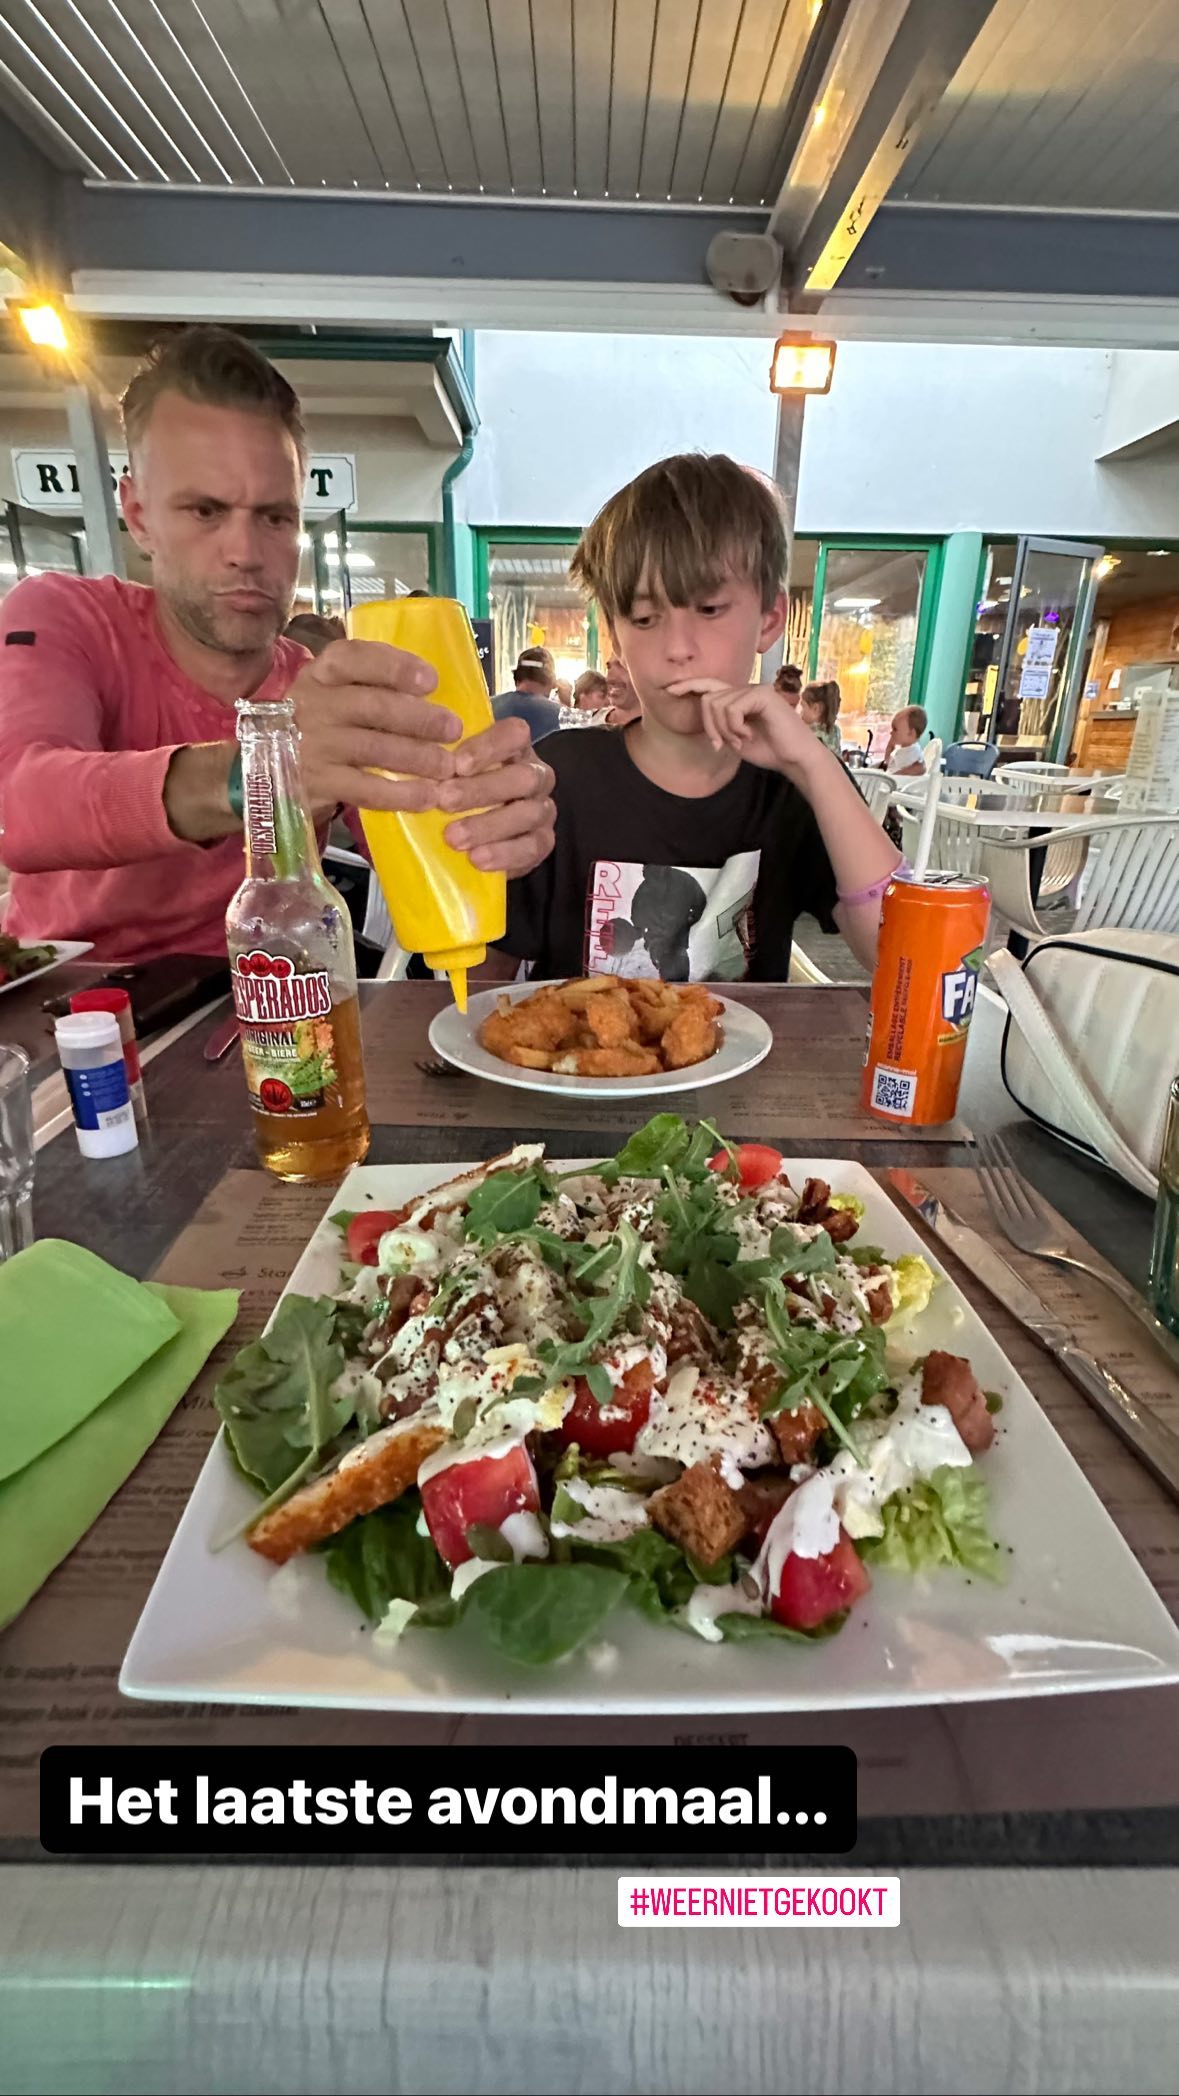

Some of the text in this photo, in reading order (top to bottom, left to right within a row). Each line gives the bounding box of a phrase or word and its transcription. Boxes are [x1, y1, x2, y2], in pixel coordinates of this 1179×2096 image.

[248, 773, 277, 853] DESPERADOS
[943, 971, 976, 1020] FA
[893, 1007, 909, 1061] RECYCLABLE
